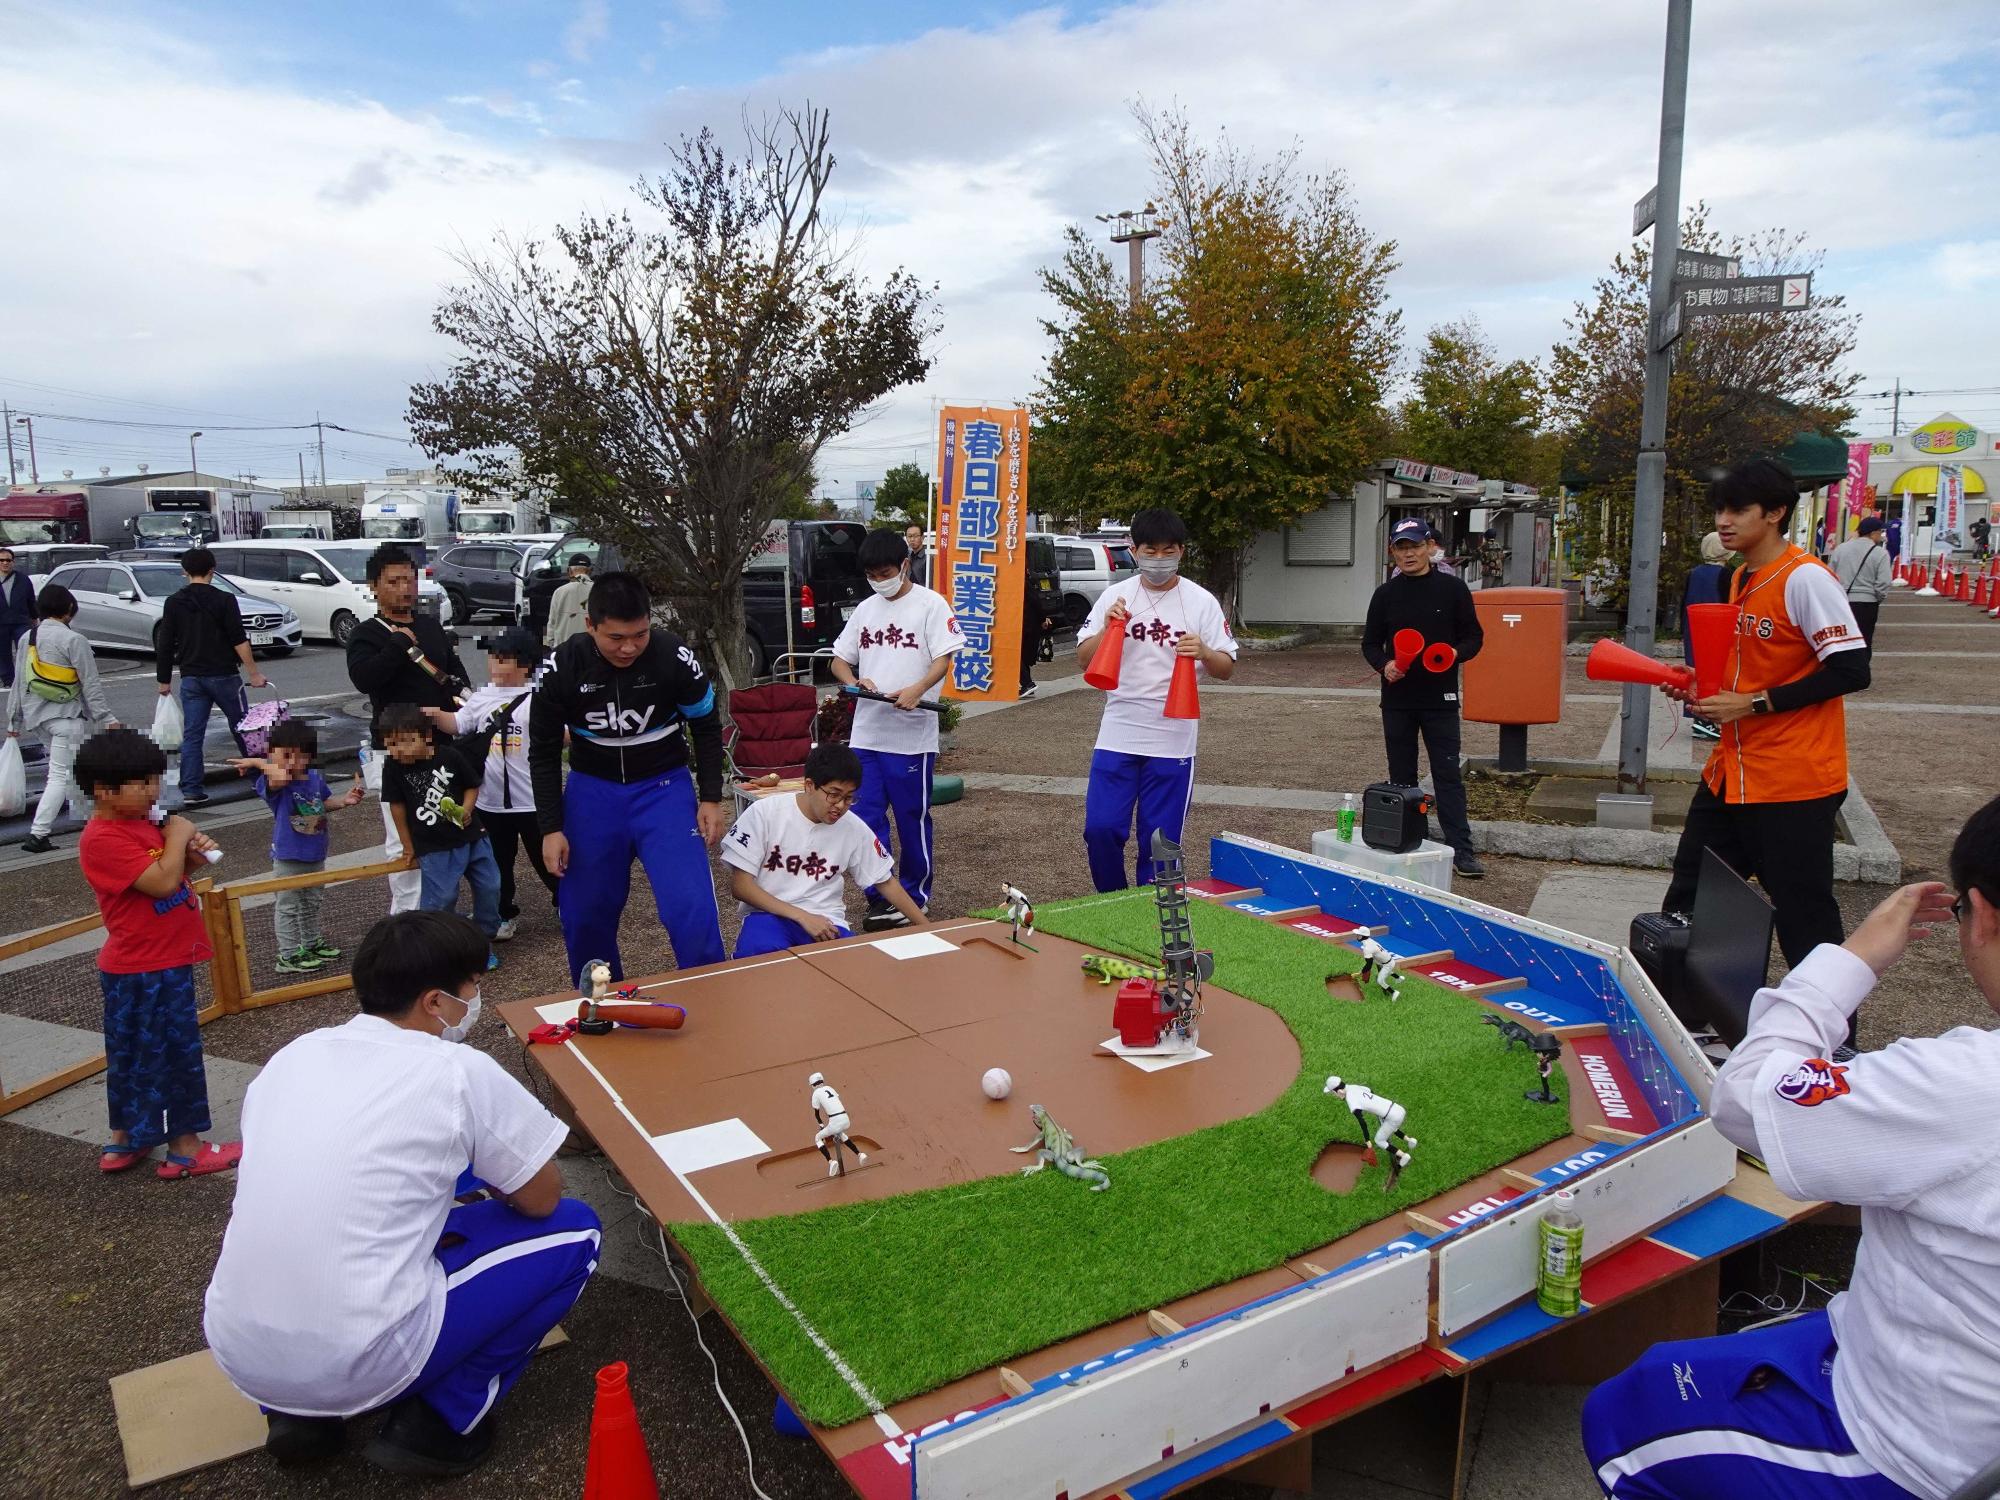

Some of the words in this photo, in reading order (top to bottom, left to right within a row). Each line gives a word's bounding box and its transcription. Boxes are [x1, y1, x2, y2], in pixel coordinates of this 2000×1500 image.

[1685, 287, 1728, 307] お買物
[953, 418, 1004, 692] 春日部工業高校
[859, 623, 919, 650] 春日部工
[585, 701, 656, 734] sky
[416, 765, 455, 826] Spark
[1235, 903, 1274, 917] OUT
[1291, 922, 1337, 938] 2BH
[1428, 971, 1476, 990] 1BH
[1503, 1001, 1566, 1024] OUT
[1580, 1054, 1633, 1119] HOMERUN
